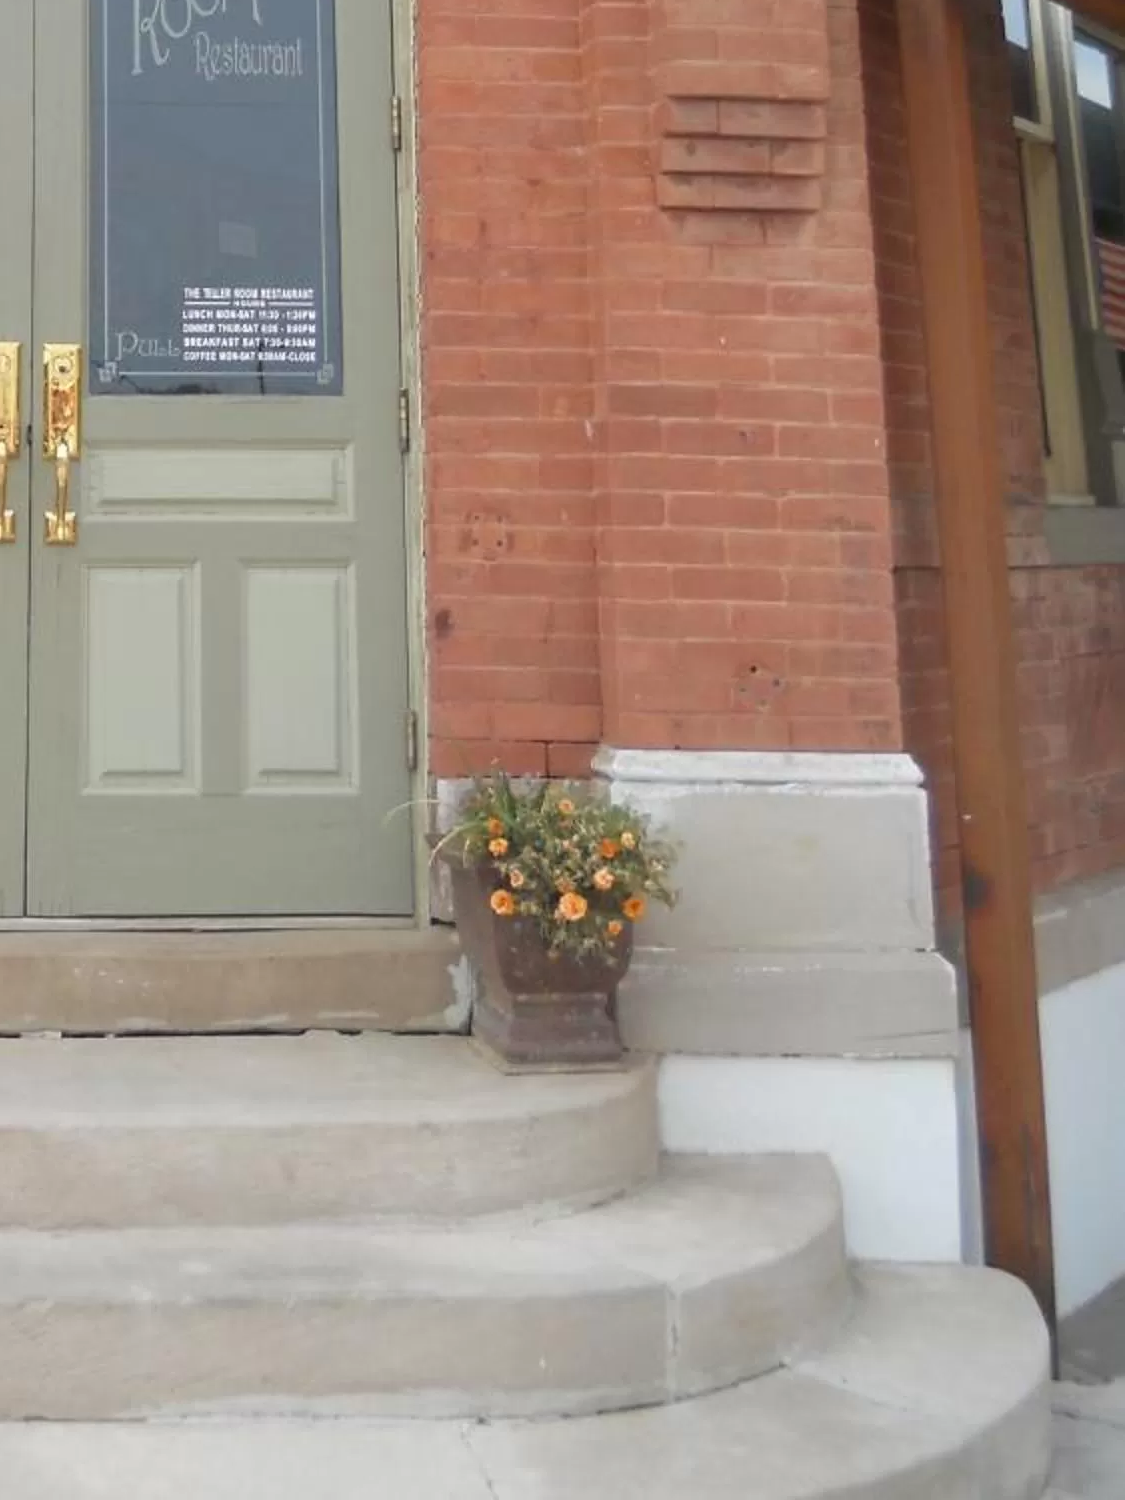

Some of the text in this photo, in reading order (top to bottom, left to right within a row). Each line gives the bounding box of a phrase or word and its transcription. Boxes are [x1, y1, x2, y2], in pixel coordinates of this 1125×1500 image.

[193, 30, 303, 81] Restaurant
[183, 287, 314, 299] THE TELLER ROOM RESTAURANT
[182, 309, 214, 320] LUNCH
[215, 309, 255, 320] MON-SAT
[182, 323, 216, 334] DINNER
[183, 337, 241, 348] BREAKFAST
[241, 337, 262, 348] SAT
[183, 351, 217, 362] COFFEE
